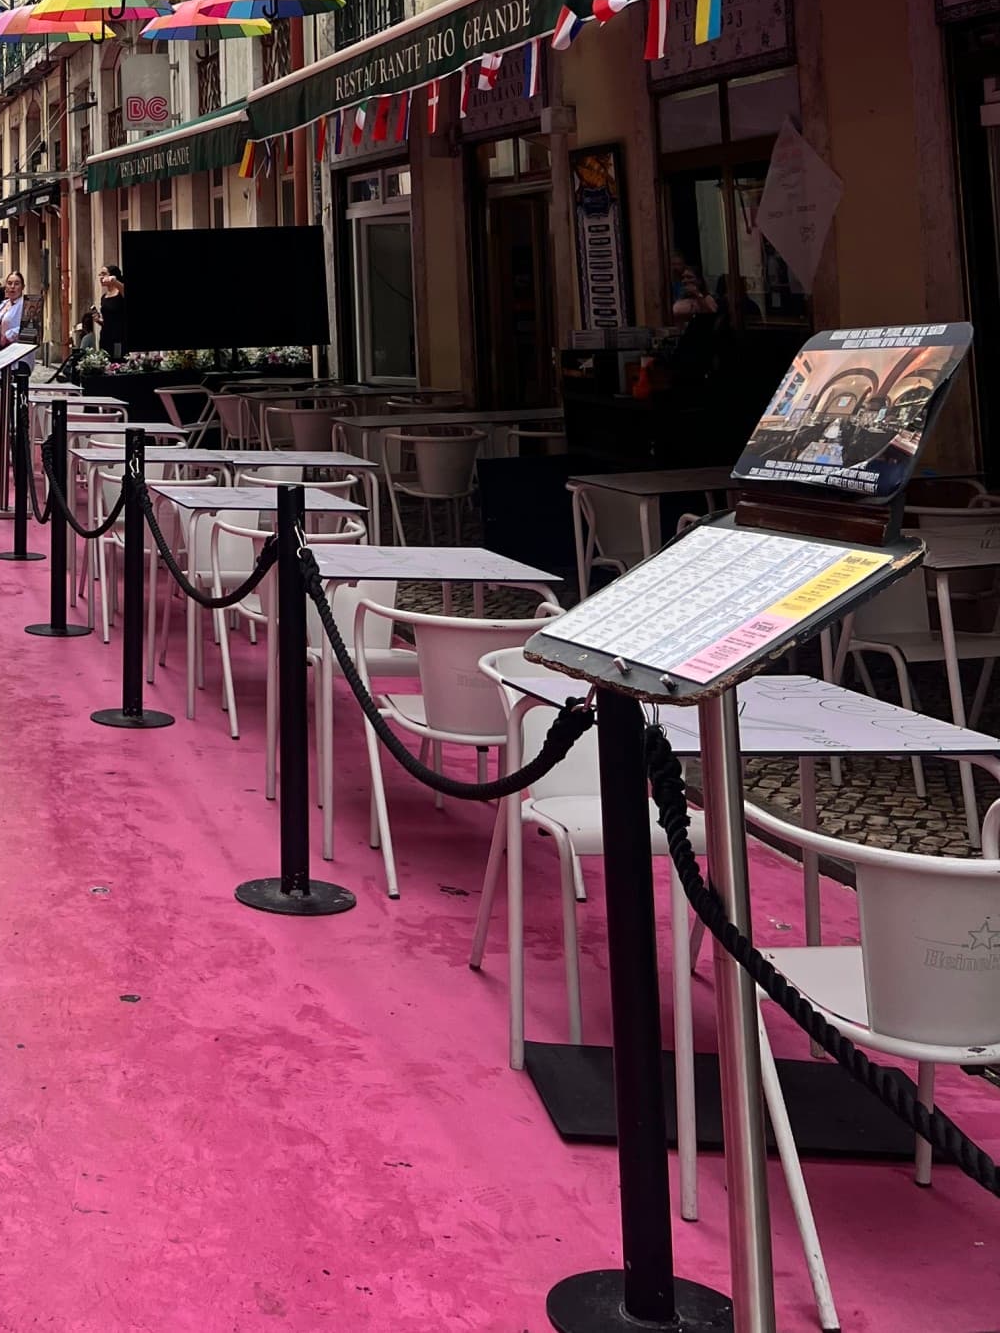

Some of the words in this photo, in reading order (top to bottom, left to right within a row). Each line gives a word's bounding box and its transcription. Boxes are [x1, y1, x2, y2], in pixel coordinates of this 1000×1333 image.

[335, 42, 422, 101] RESTAURANTE
[427, 28, 456, 65] RIO
[126, 96, 169, 122] BC
